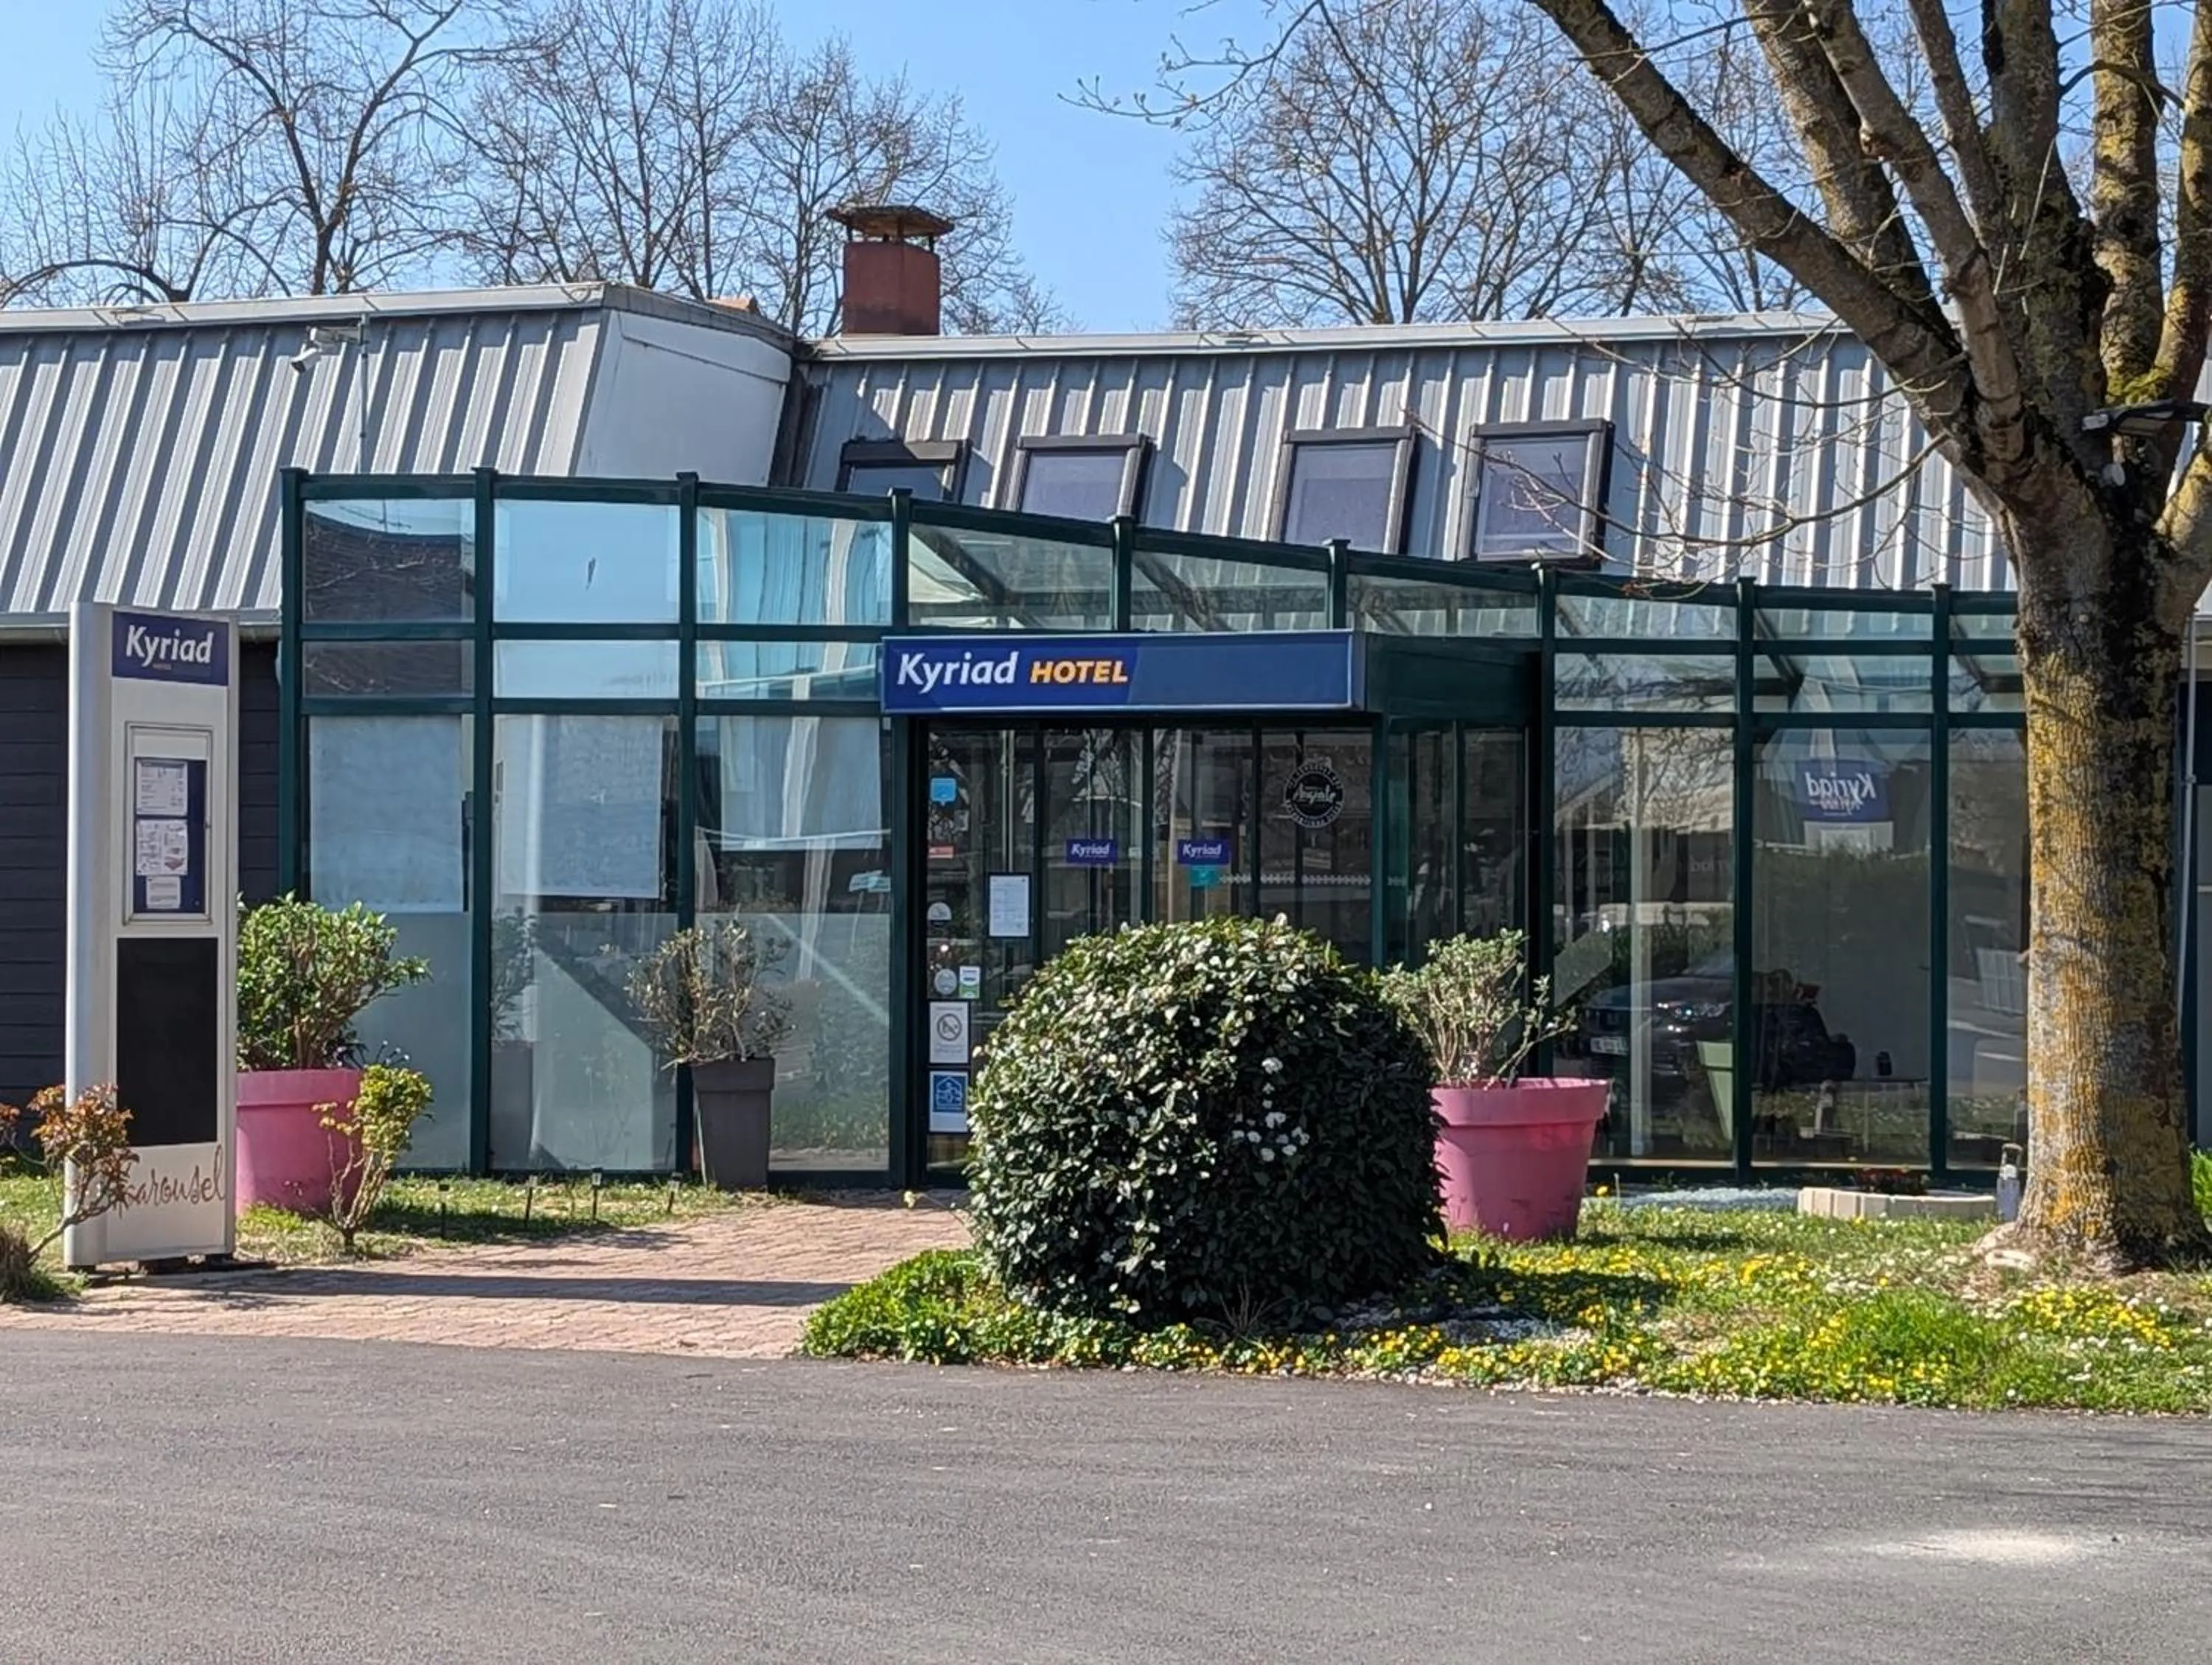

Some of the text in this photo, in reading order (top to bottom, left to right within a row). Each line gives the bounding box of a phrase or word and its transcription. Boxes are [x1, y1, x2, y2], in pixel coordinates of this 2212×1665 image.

[126, 625, 215, 667] Kyriad
[897, 650, 1129, 695] Kyriad HOTEL
[1071, 843, 1110, 858] Kyriad
[1183, 843, 1222, 858] Kyriad
[122, 1144, 226, 1206] arousel
